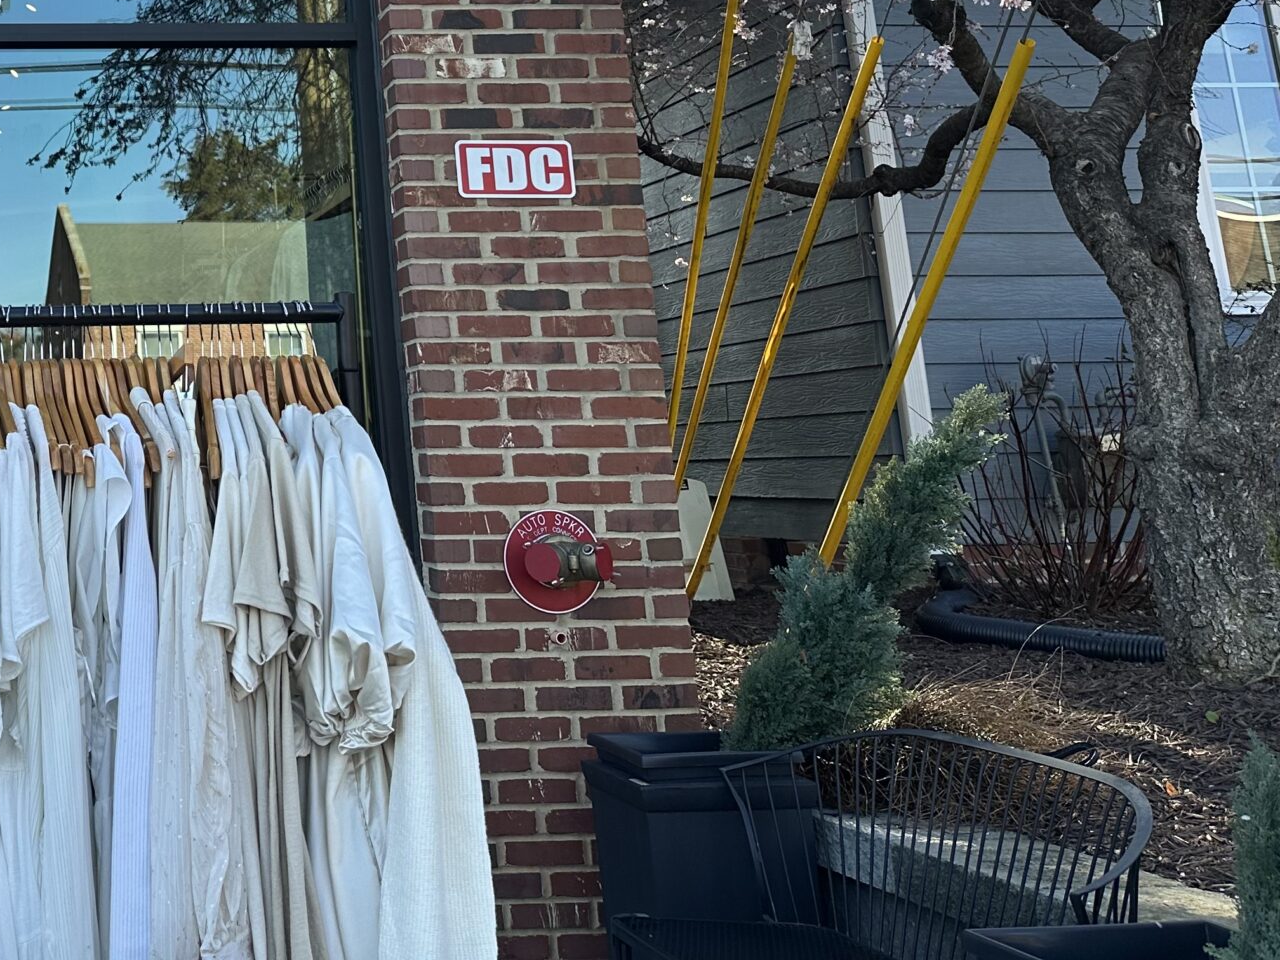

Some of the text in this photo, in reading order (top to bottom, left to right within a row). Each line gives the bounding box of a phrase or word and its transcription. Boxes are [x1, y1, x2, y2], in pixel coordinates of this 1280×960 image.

[465, 147, 565, 191] FDC
[517, 514, 585, 539] AUTO SPKR
